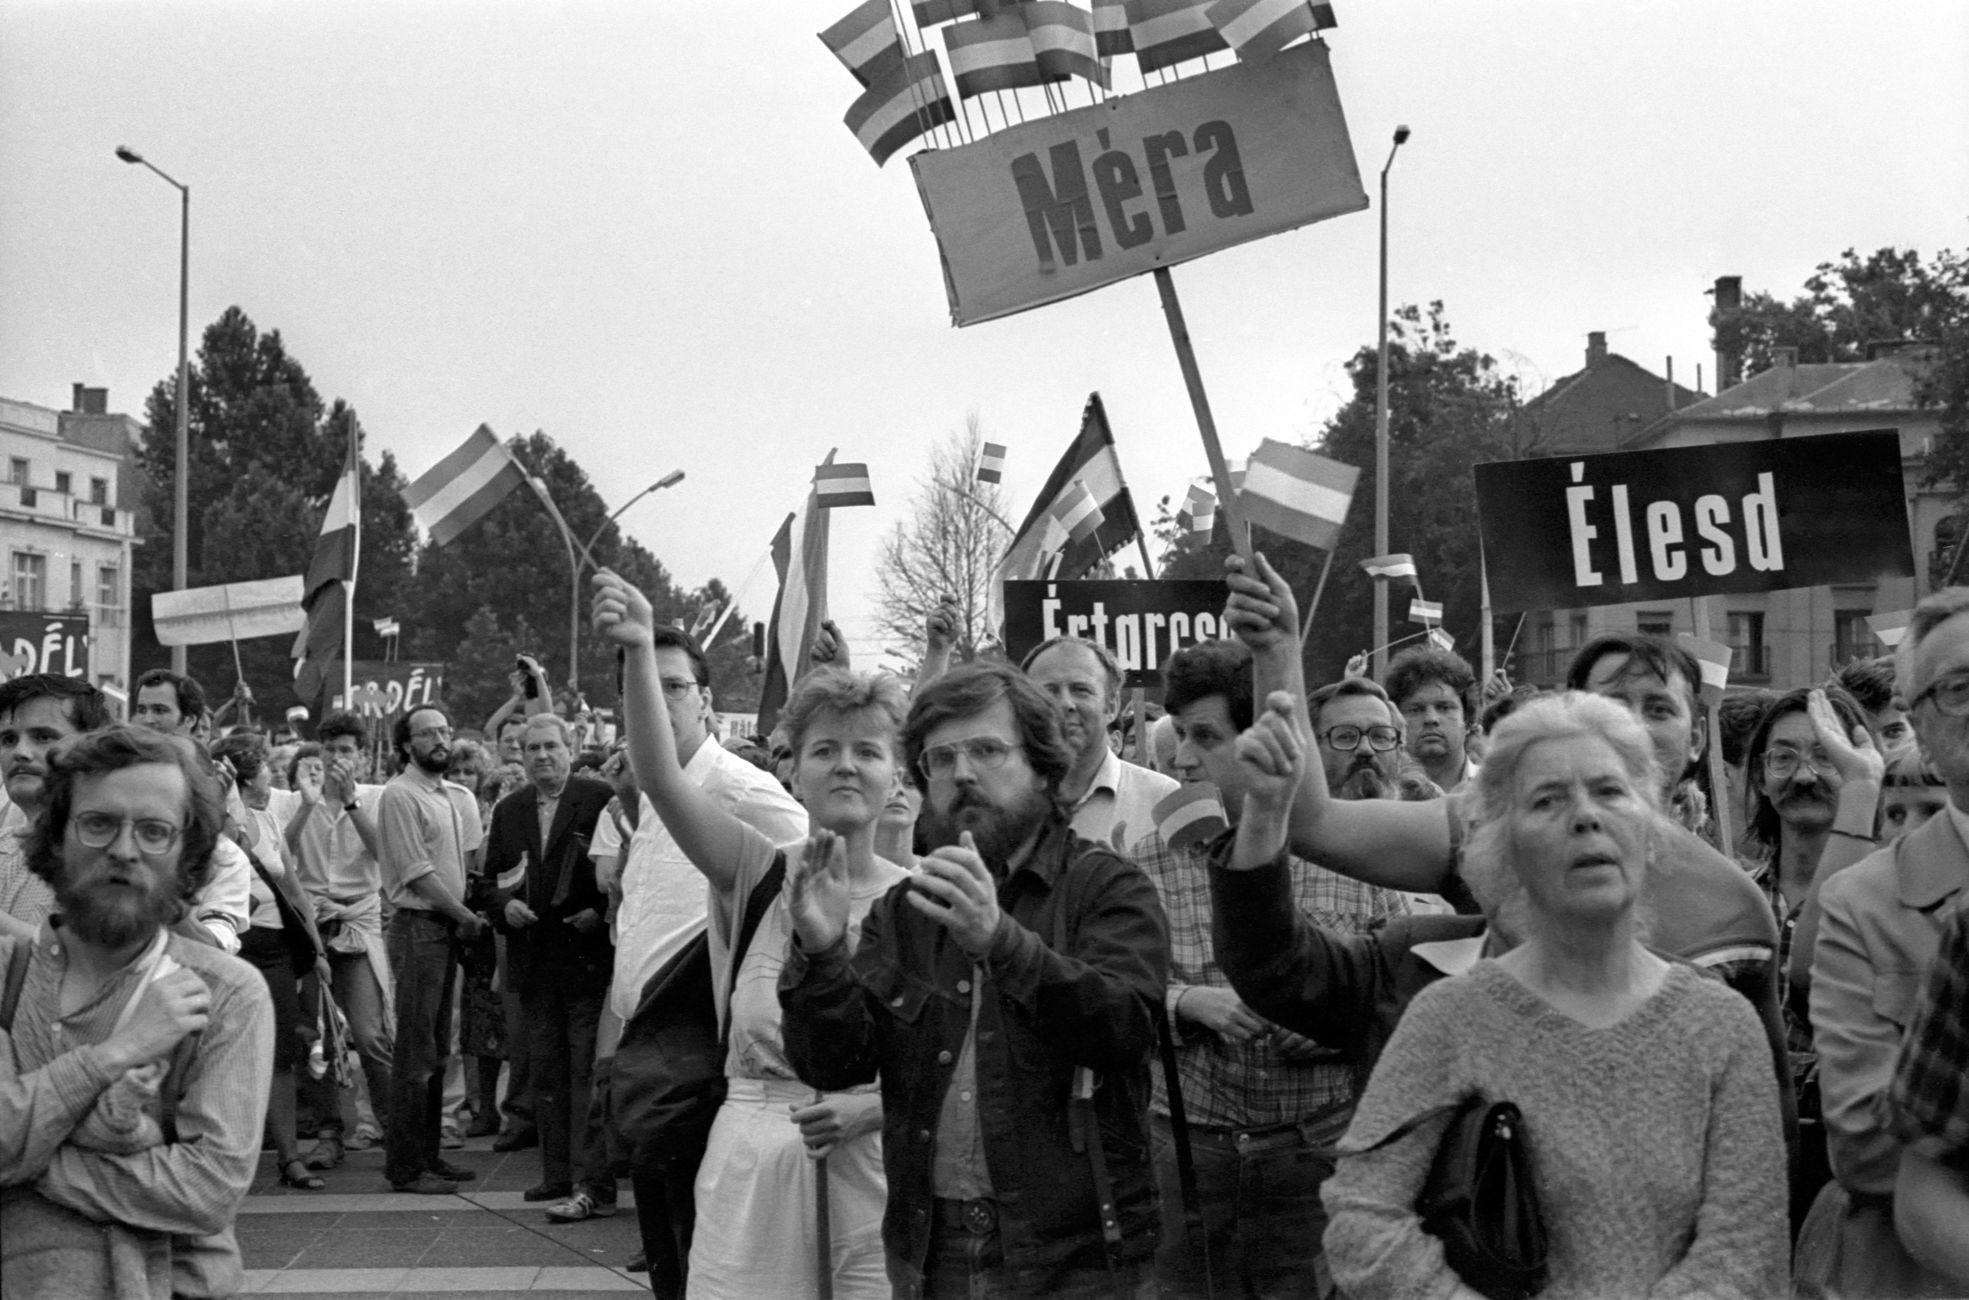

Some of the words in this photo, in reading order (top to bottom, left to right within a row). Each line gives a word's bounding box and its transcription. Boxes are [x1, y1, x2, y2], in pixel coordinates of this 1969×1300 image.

[1011, 120, 1254, 274] Méra
[1565, 461, 1785, 587] Élesd
[0, 622, 88, 684] DÉL
[1042, 584, 1235, 670] Értarcs
